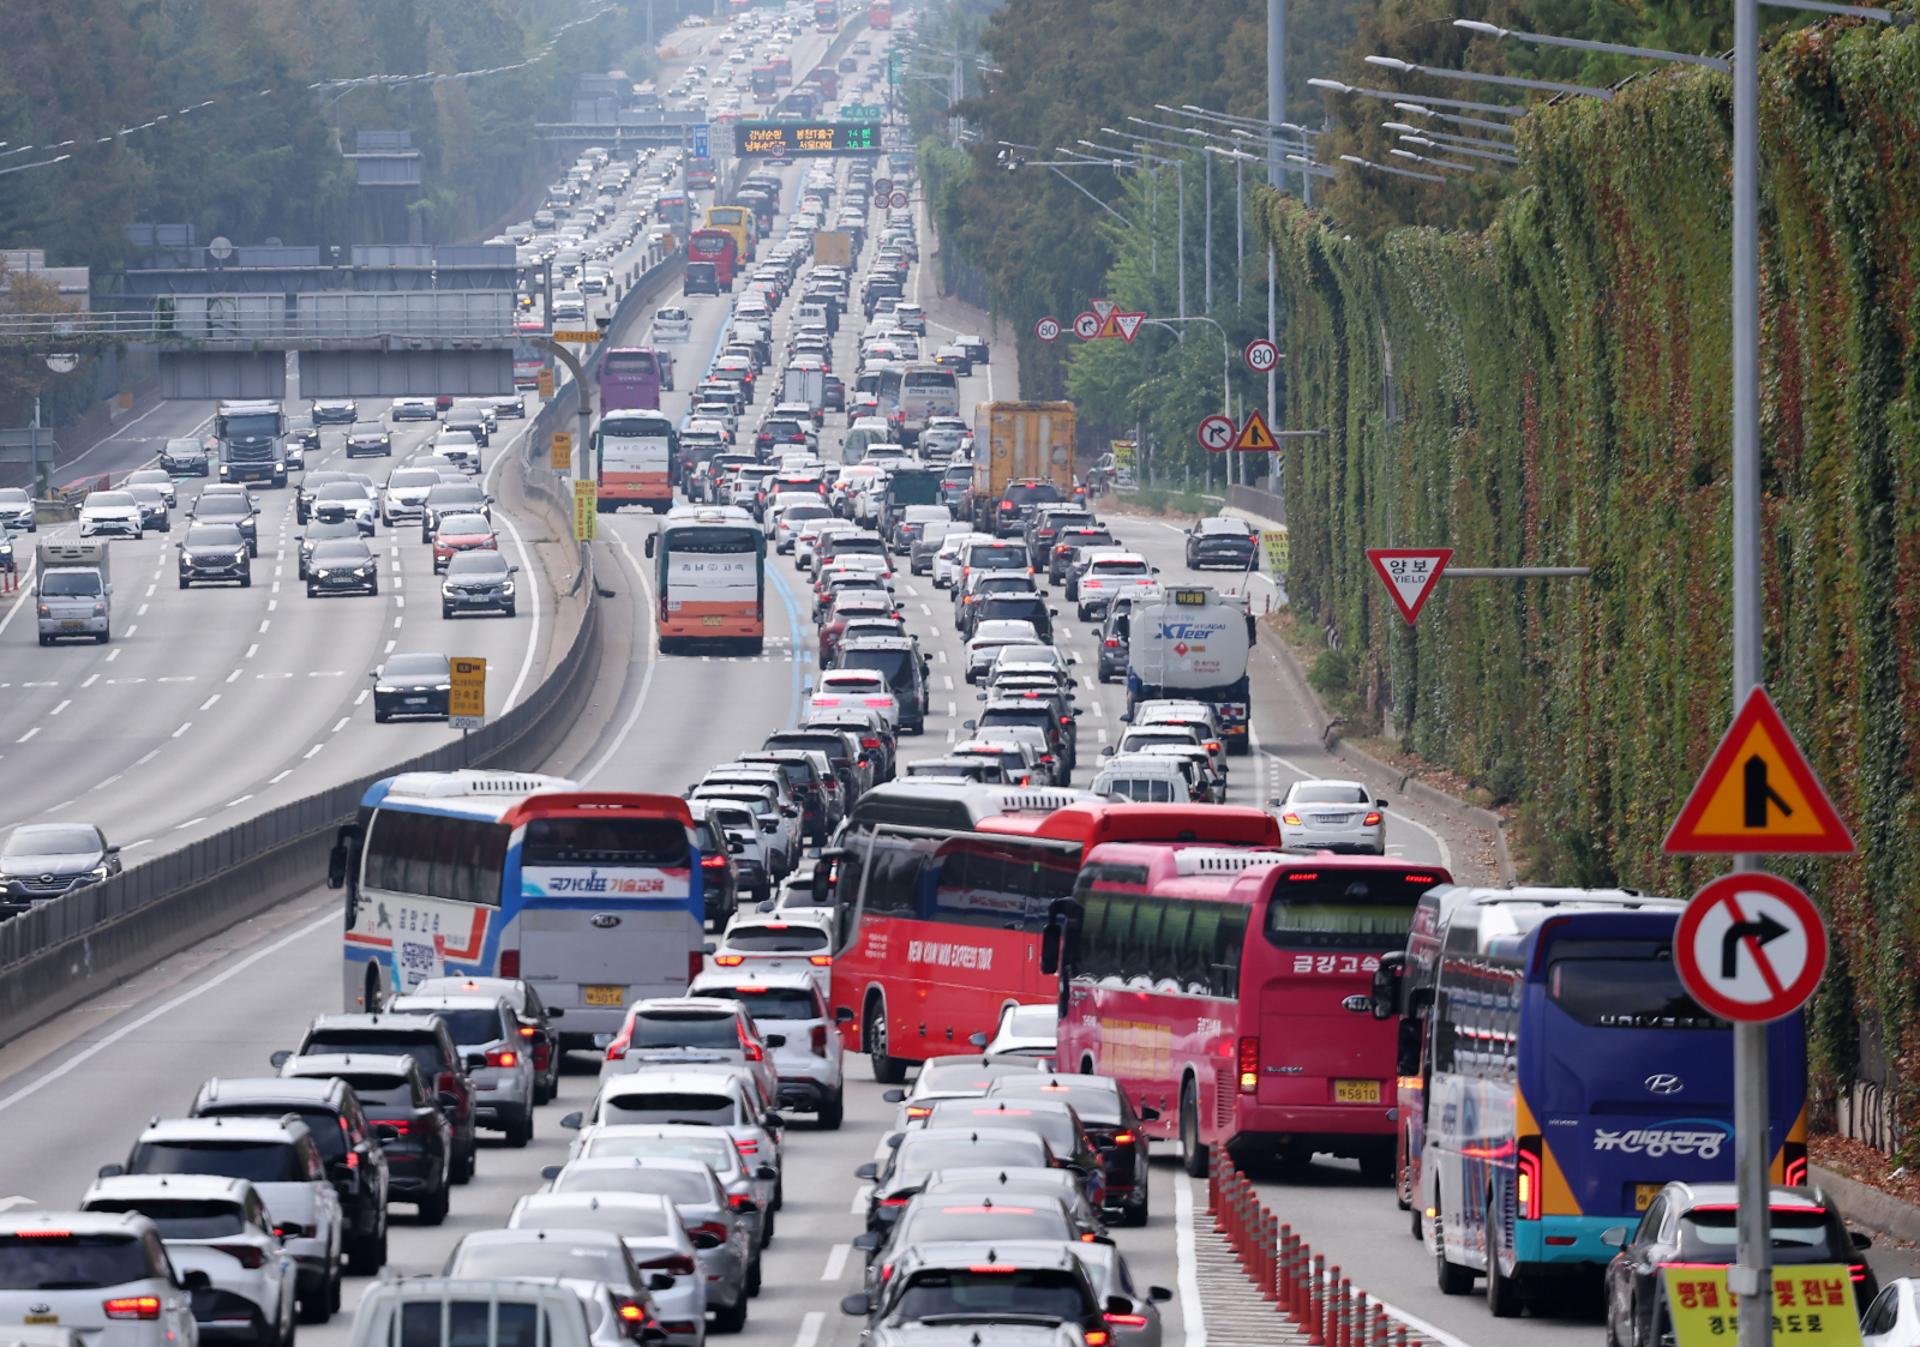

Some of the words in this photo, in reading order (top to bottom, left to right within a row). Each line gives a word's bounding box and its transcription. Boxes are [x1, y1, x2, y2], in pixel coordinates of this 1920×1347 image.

[1253, 349, 1272, 364] 80
[1389, 560, 1428, 574] 양보
[1394, 575, 1426, 583] YIELD
[1154, 623, 1215, 639] XTeer
[548, 871, 608, 892] 국가대표
[610, 878, 664, 892] 기술교육
[1293, 955, 1380, 974] 금강고속
[1677, 1281, 1719, 1309] 명절
[1800, 1279, 1844, 1306] 전날
[1709, 1315, 1823, 1335] 경부속도로
